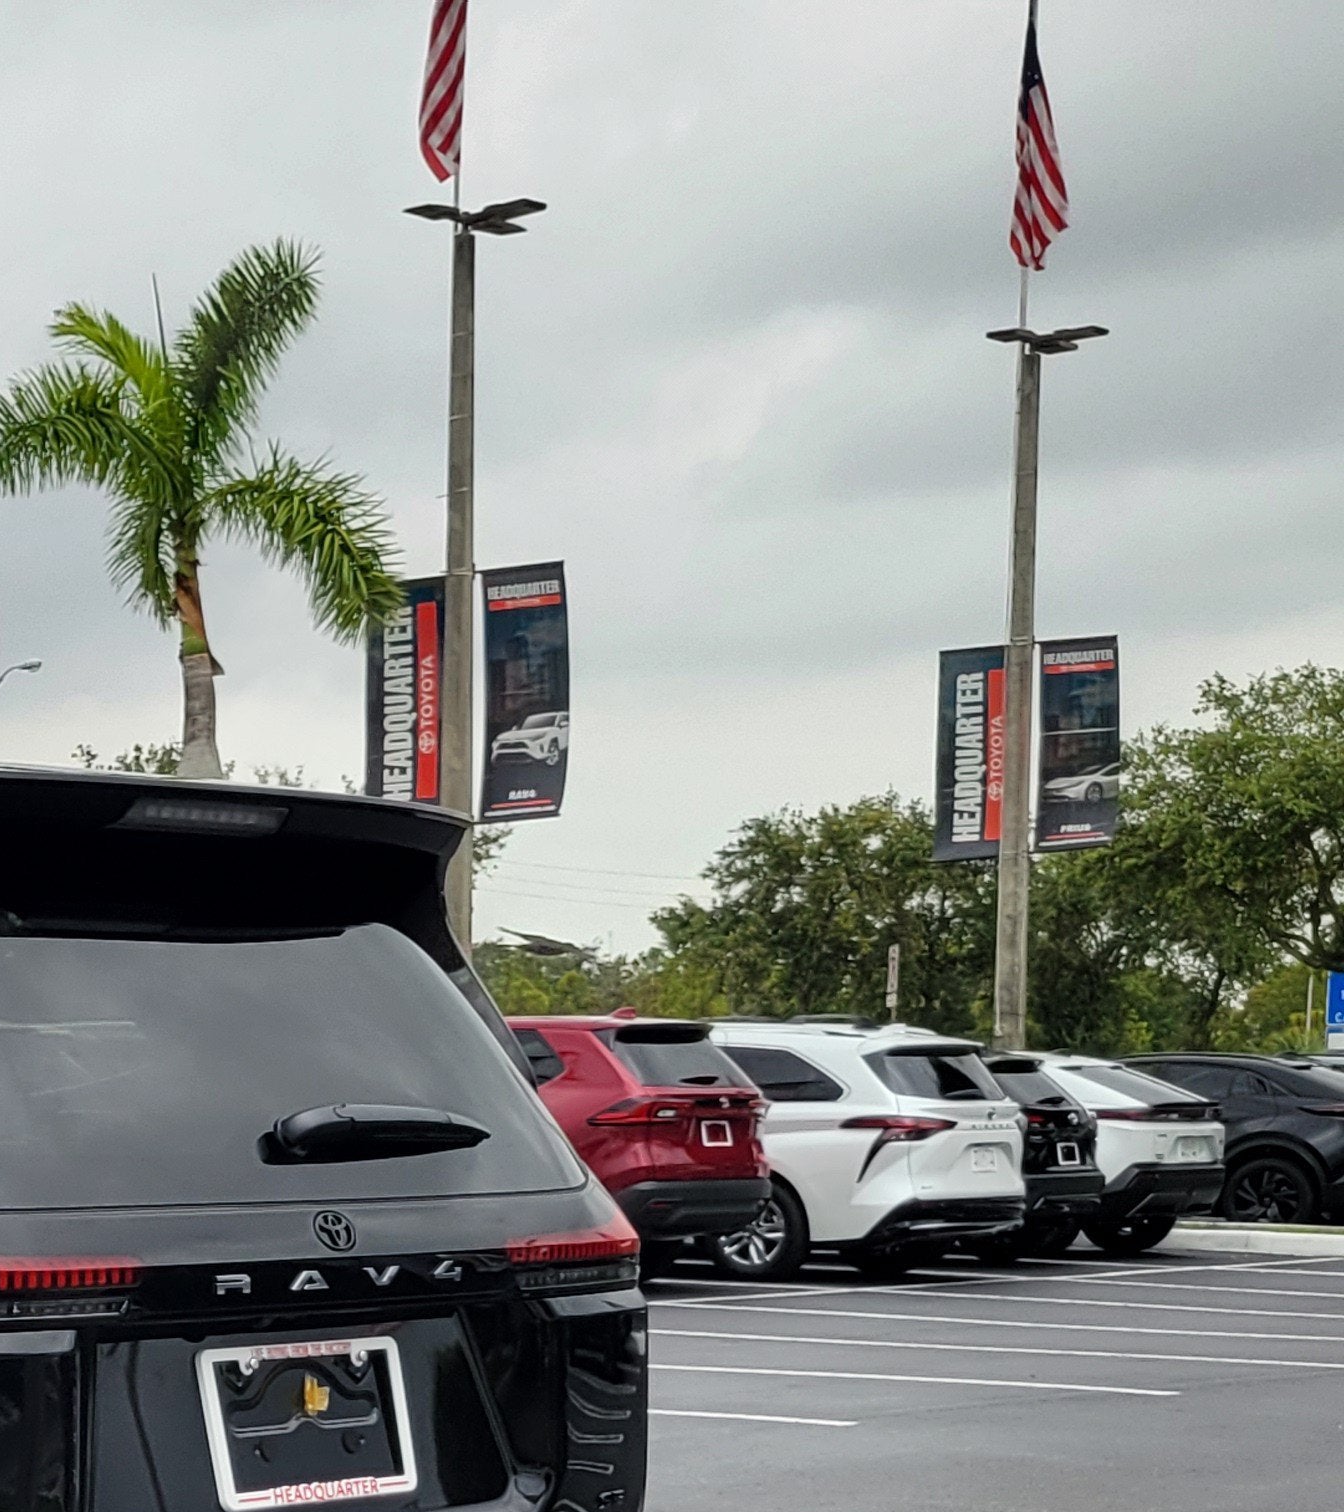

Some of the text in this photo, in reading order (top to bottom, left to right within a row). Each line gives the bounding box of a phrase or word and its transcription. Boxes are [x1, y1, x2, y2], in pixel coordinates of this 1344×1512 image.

[420, 655, 435, 728] TOYOTA
[952, 672, 986, 843] HEADQUARTER
[987, 716, 1005, 778] TOYOTA
[215, 1260, 462, 1295] RAV4
[274, 1479, 379, 1504] HEADQUARTER
